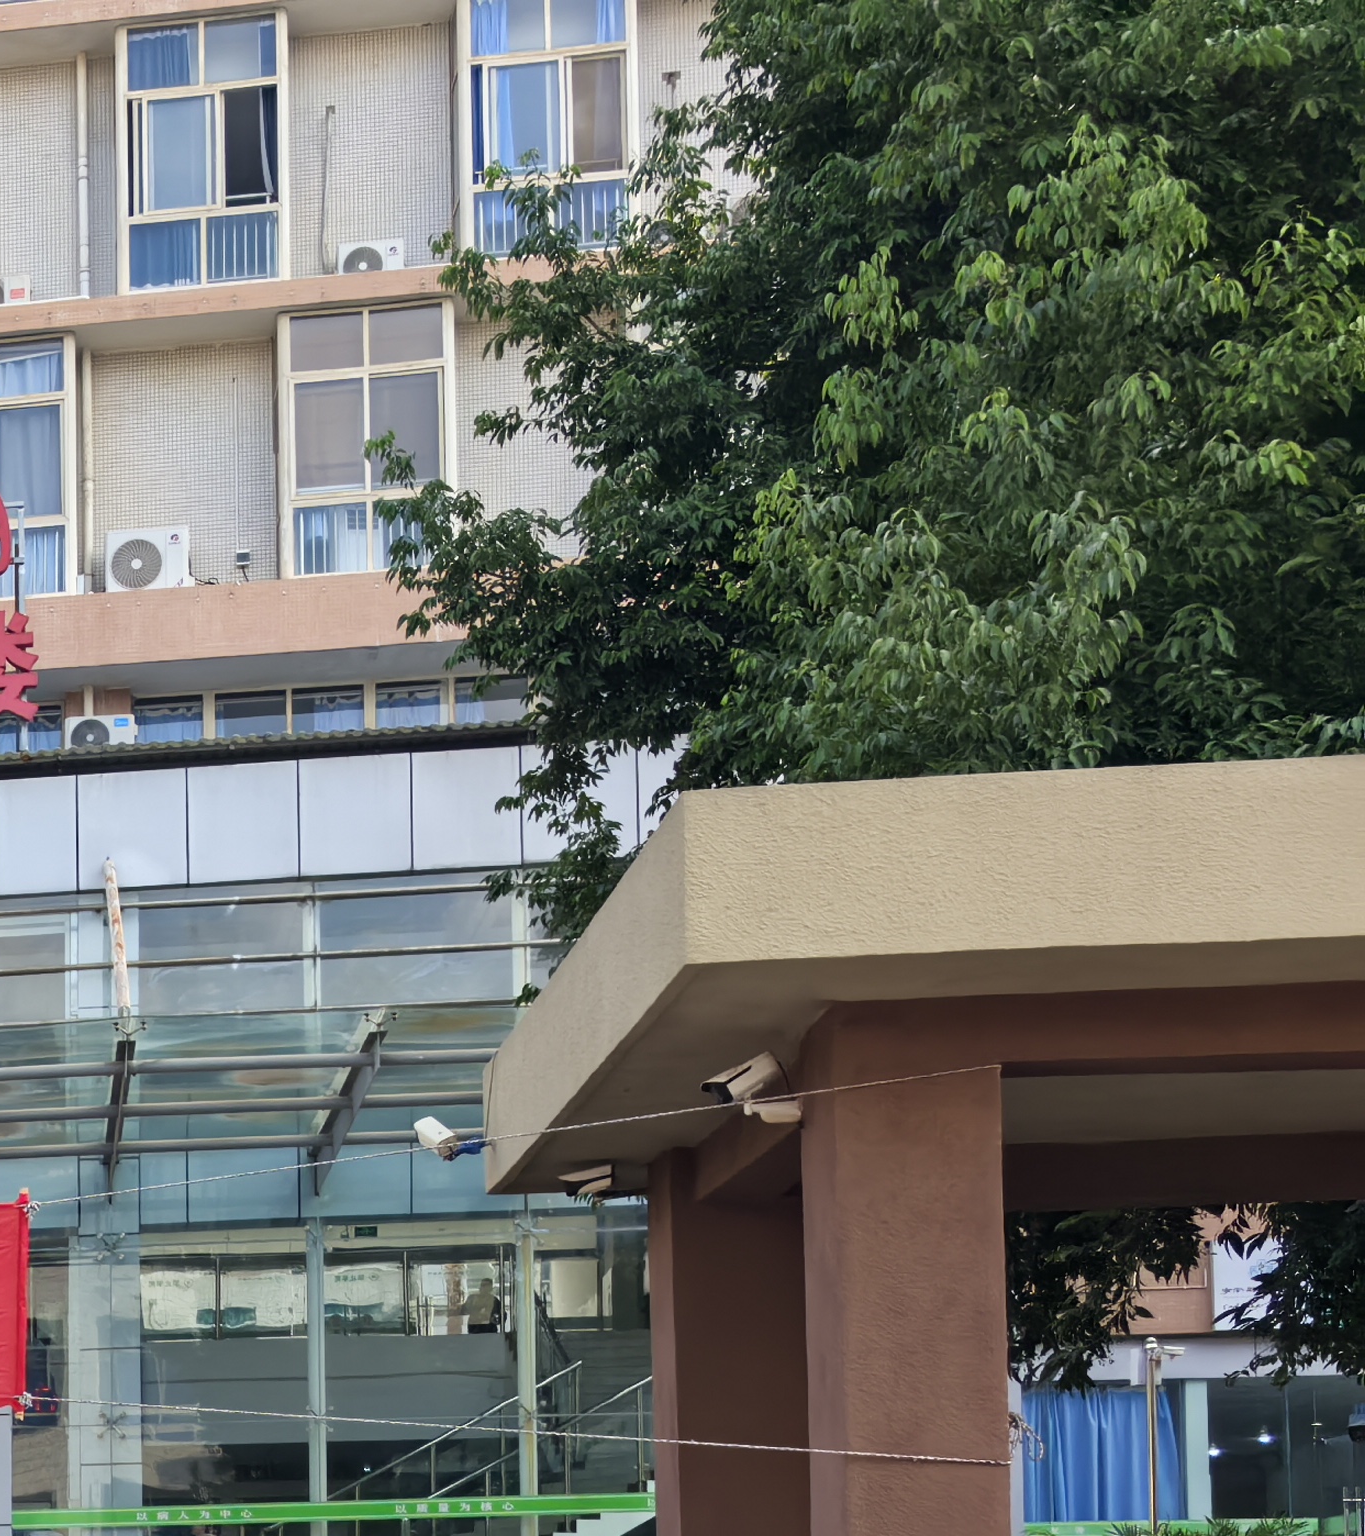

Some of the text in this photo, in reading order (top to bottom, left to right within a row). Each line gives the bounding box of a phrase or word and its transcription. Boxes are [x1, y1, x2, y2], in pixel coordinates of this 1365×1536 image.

[136, 1506, 254, 1522] 以病人为中心
[395, 1500, 516, 1515] 以质量为核心
